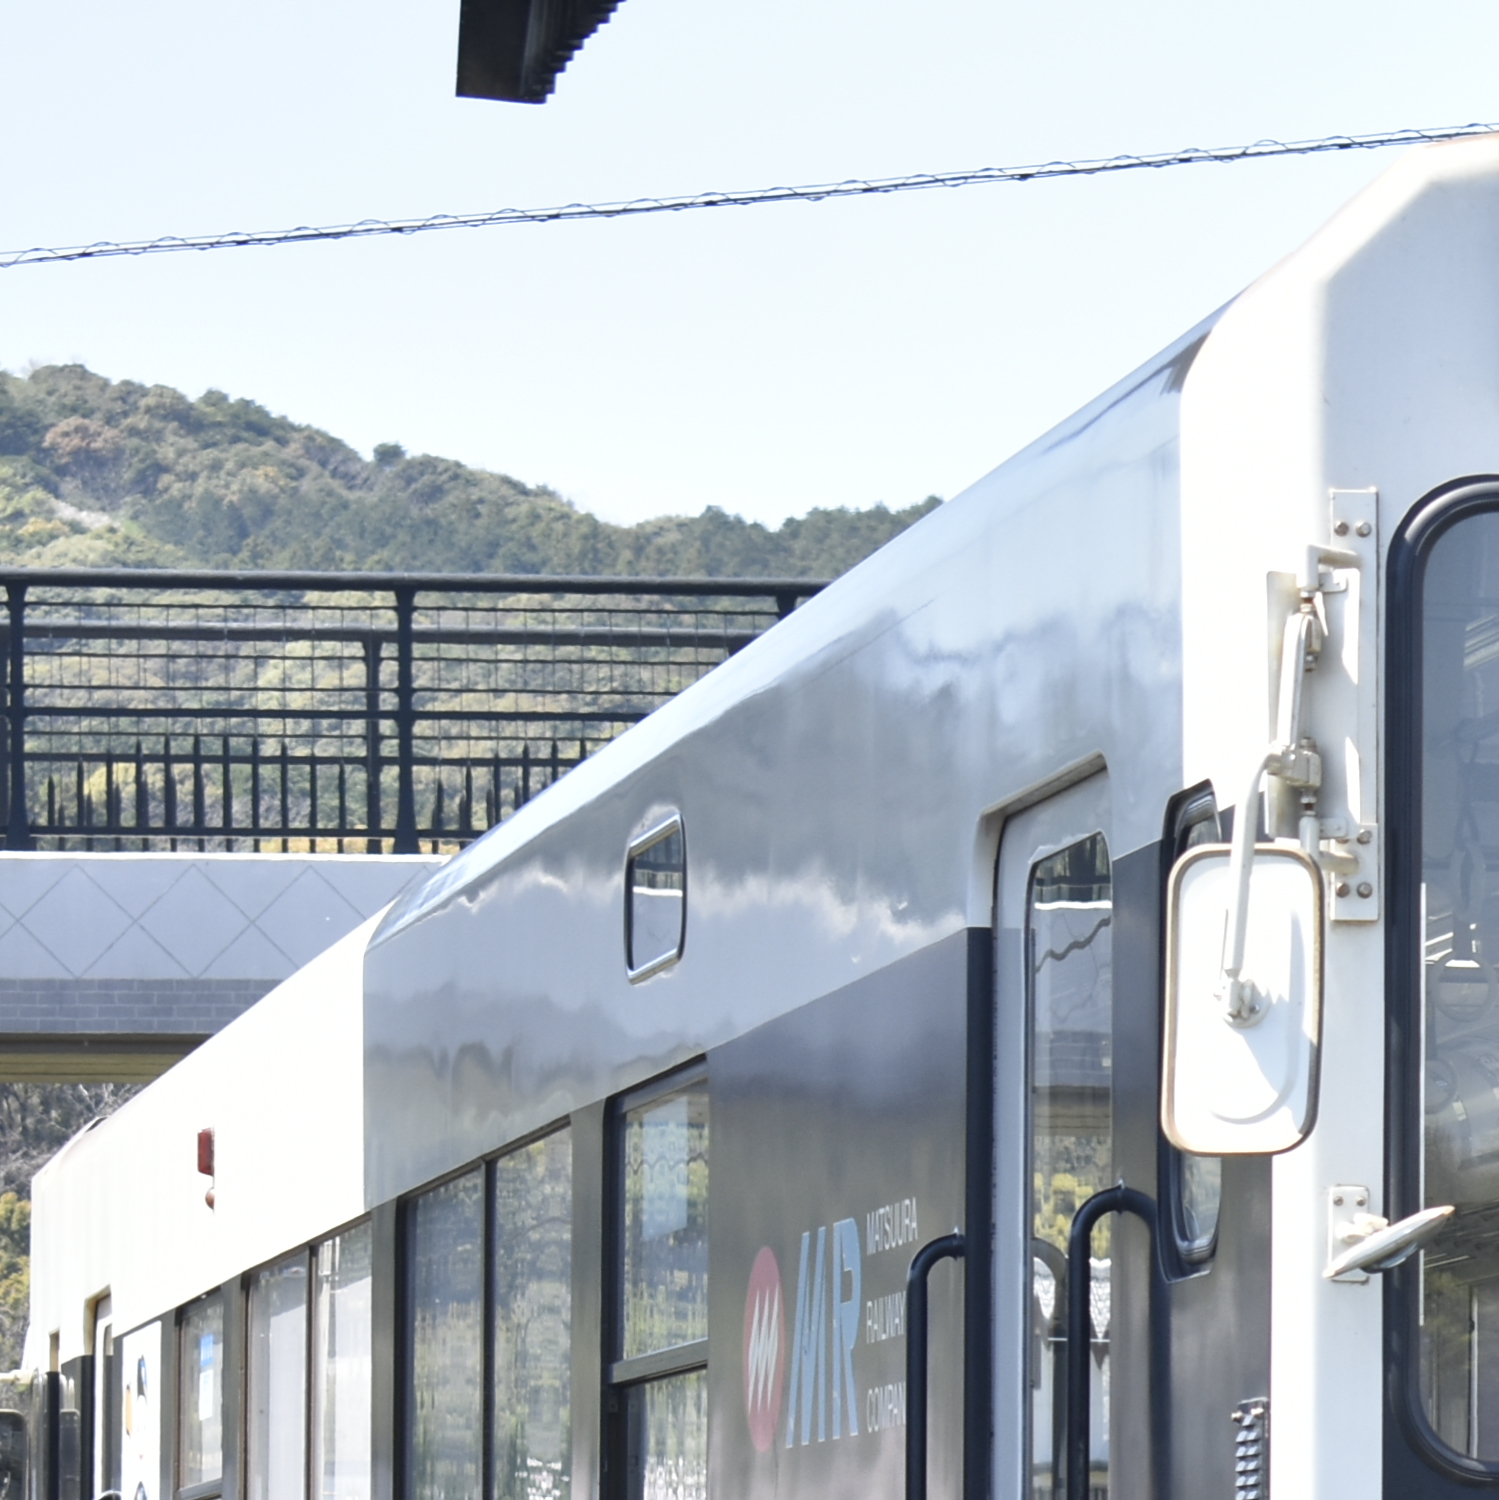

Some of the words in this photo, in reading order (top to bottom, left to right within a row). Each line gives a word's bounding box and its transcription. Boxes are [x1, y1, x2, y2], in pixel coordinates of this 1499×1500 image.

[866, 1197, 919, 1256] MATSUURA
[785, 1217, 861, 1449] MR
[866, 1380, 906, 1434] COMPAN
